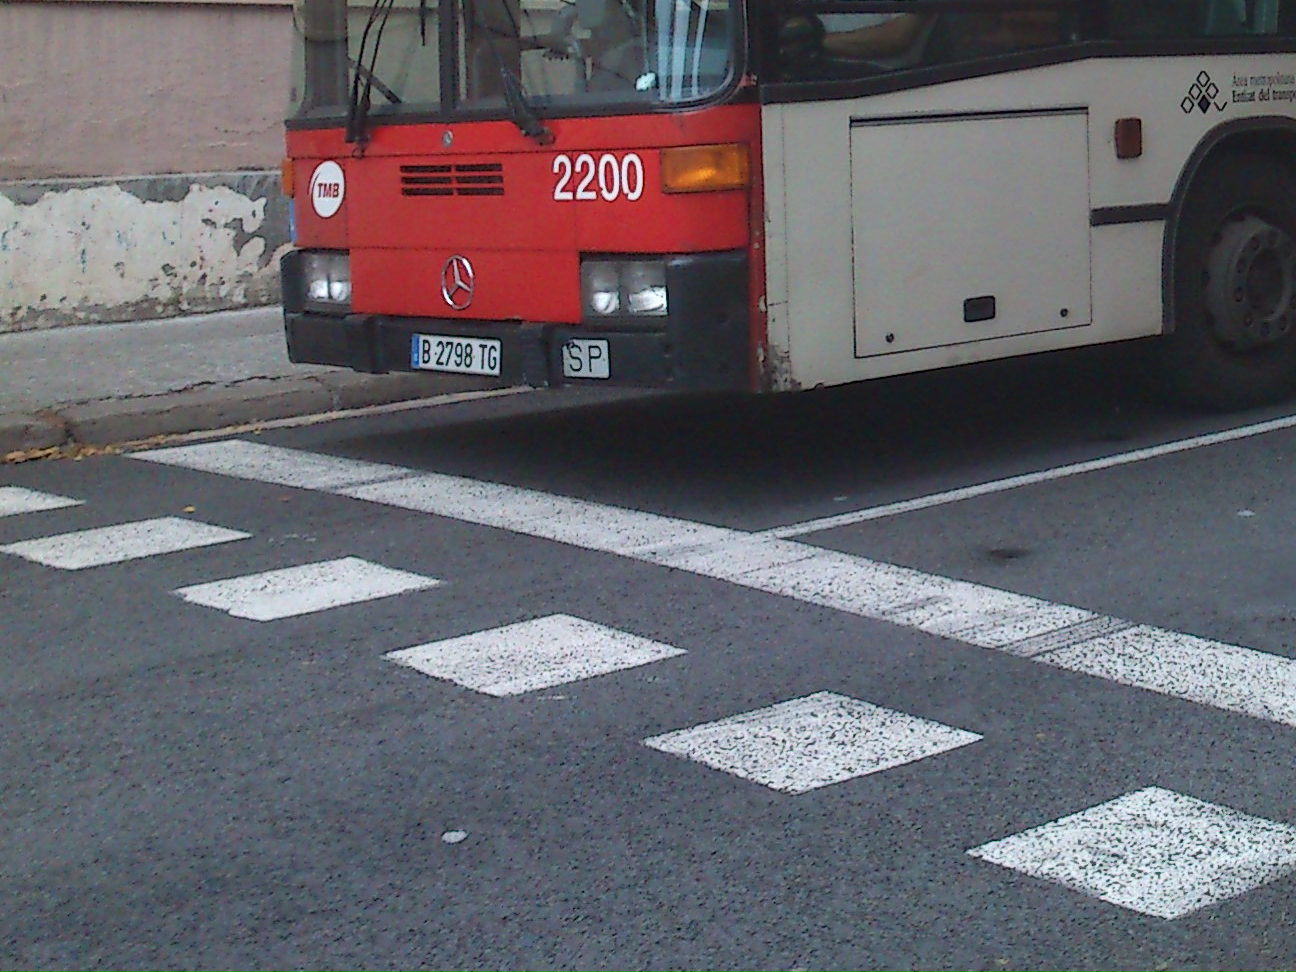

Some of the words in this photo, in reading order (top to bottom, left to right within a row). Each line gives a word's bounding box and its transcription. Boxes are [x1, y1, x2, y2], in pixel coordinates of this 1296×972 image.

[1258, 88, 1270, 101] del
[317, 183, 340, 198] TMB
[552, 153, 644, 202] 2200
[421, 339, 430, 365] B
[435, 340, 473, 369] 2798
[478, 343, 498, 371] TG
[568, 344, 603, 373] SP
